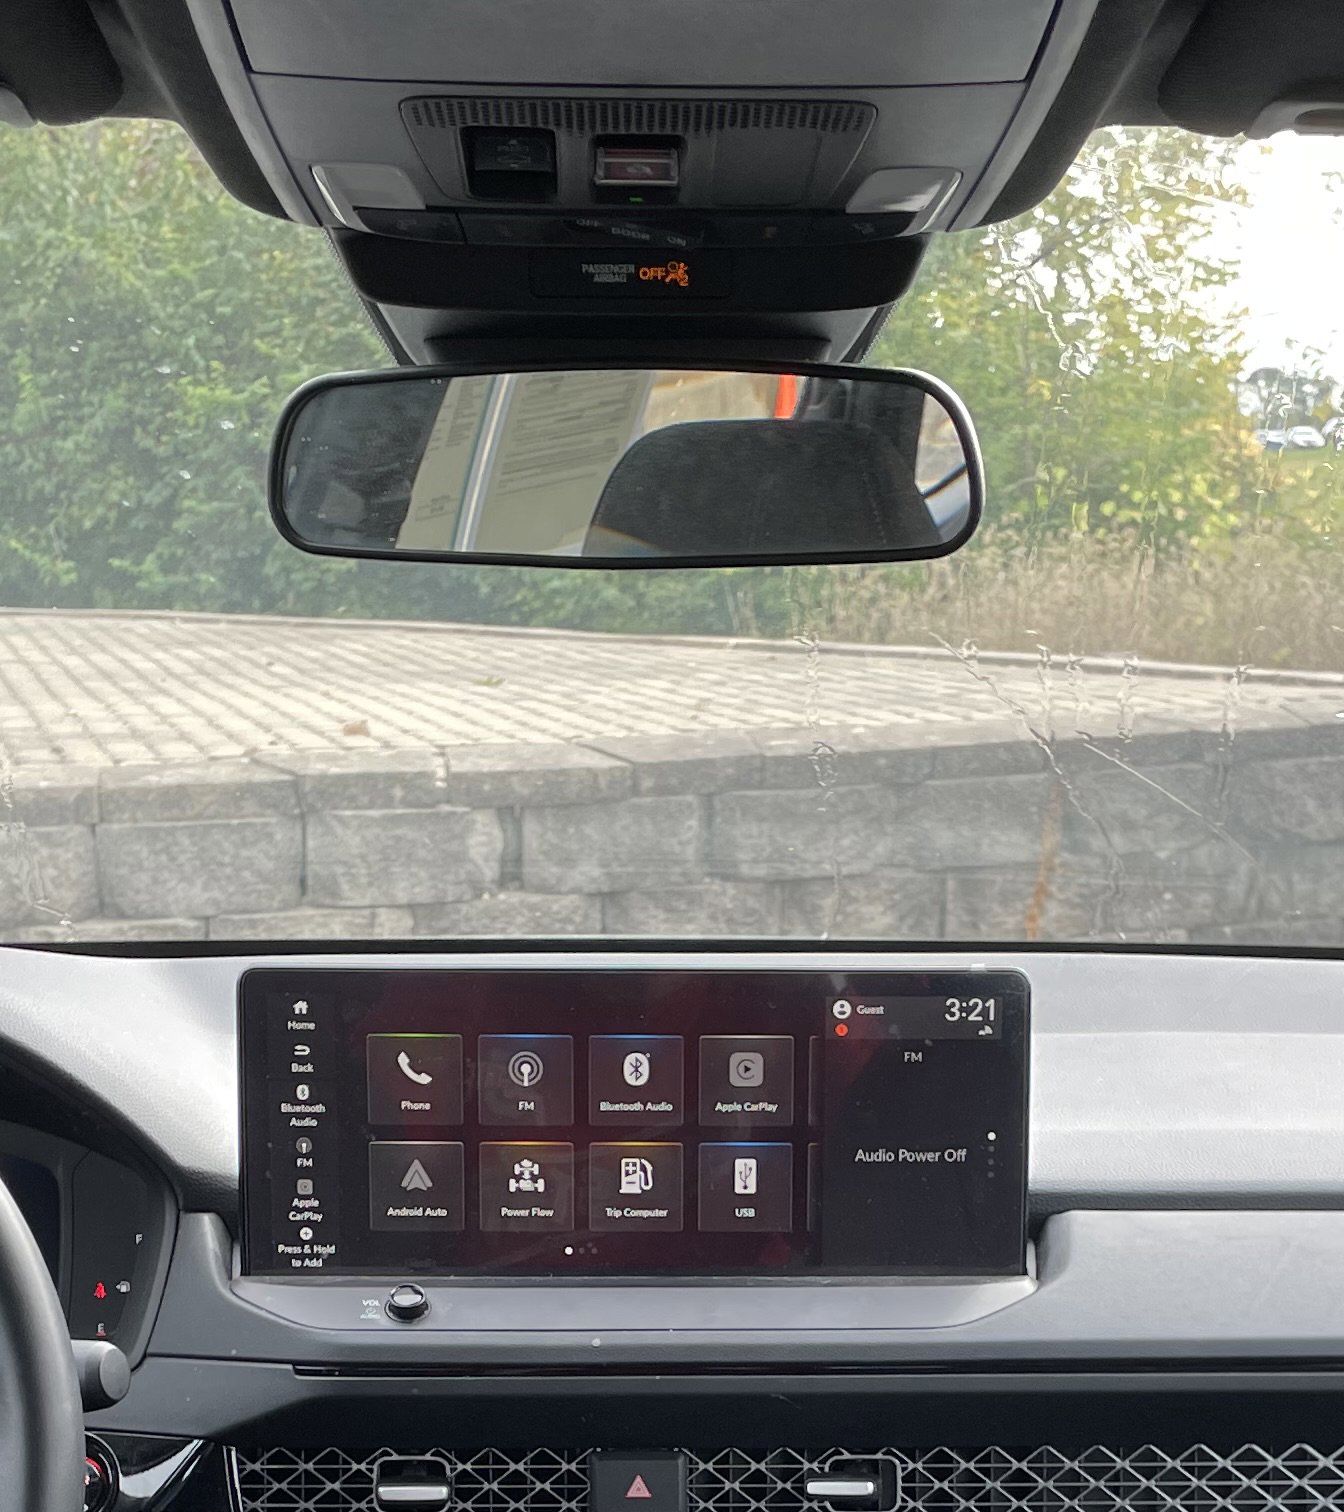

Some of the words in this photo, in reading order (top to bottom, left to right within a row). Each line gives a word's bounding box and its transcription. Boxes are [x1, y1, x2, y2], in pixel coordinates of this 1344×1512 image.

[610, 226, 650, 241] DOOR
[581, 263, 635, 273] PASSENGER
[639, 267, 666, 280] OFF
[593, 273, 627, 282] AIRBAG
[856, 1004, 885, 1015] Guest
[945, 998, 995, 1021] 3:21
[287, 1020, 315, 1031] Home
[903, 1051, 923, 1062] FM
[291, 1062, 314, 1073] Back
[280, 1102, 326, 1113] Bluetooth
[400, 1100, 431, 1110] Phone
[517, 1101, 535, 1111] FM
[599, 1101, 644, 1111] Bluetooth
[645, 1101, 674, 1111] Audio
[714, 1102, 742, 1113] Apple
[743, 1101, 778, 1113] CarPlay
[289, 1116, 318, 1127] Audio
[854, 1149, 895, 1162] Audio
[897, 1149, 942, 1162] Power
[943, 1149, 967, 1162] Off
[296, 1158, 313, 1168] FM
[292, 1198, 320, 1209] Apple
[288, 1210, 323, 1223] CarPlay
[386, 1207, 423, 1217] Android
[424, 1207, 448, 1217] Auto
[501, 1207, 530, 1217] Power
[531, 1207, 554, 1217] Flow
[606, 1208, 622, 1219] Trip
[623, 1208, 668, 1219] Computer
[735, 1208, 756, 1218] USB
[277, 1244, 302, 1254] Press
[303, 1244, 312, 1254] &
[313, 1244, 336, 1254] Hold
[291, 1258, 302, 1268] to
[303, 1257, 323, 1267] Add
